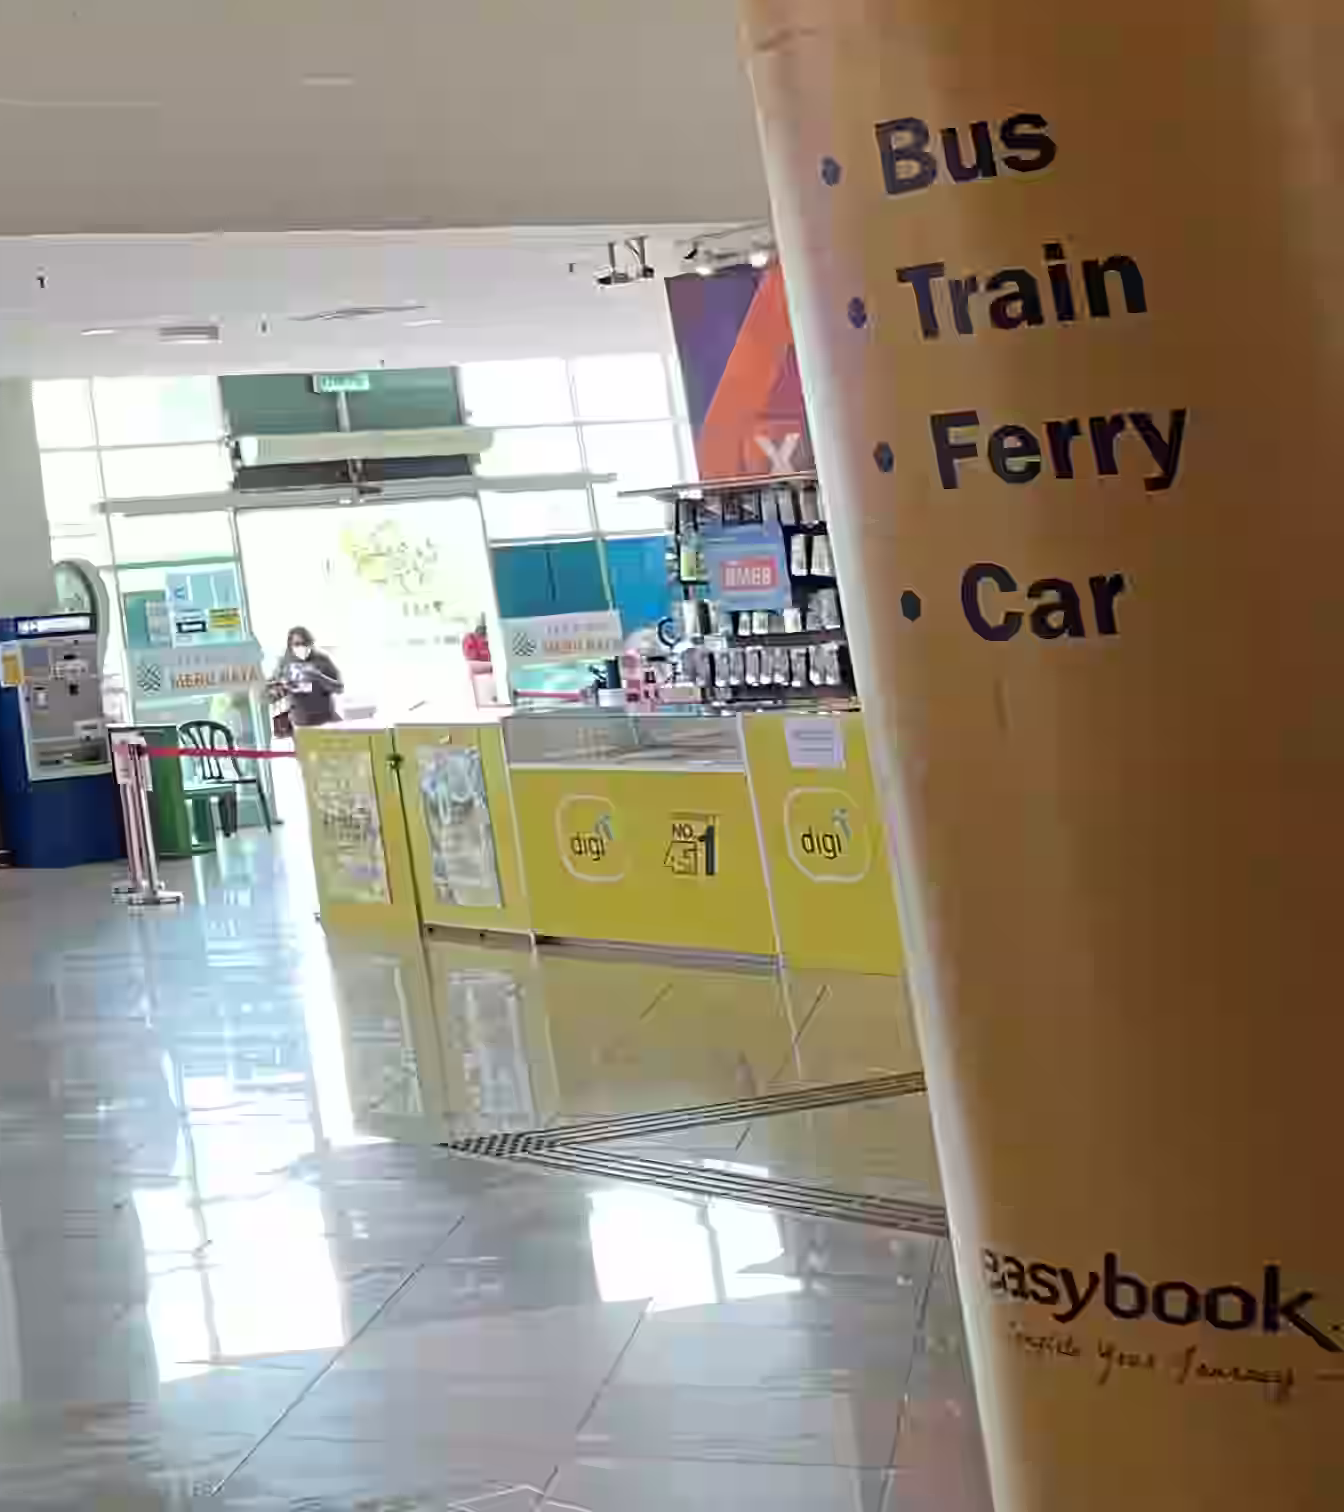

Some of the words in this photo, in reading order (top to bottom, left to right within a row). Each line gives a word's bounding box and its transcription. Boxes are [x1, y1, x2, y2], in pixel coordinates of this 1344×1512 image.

[874, 112, 1057, 195] Bus
[897, 240, 1148, 340] Train
[929, 408, 1187, 492] Ferry
[960, 562, 1127, 642] Car
[570, 831, 607, 862] digi
[801, 826, 843, 860] digi
